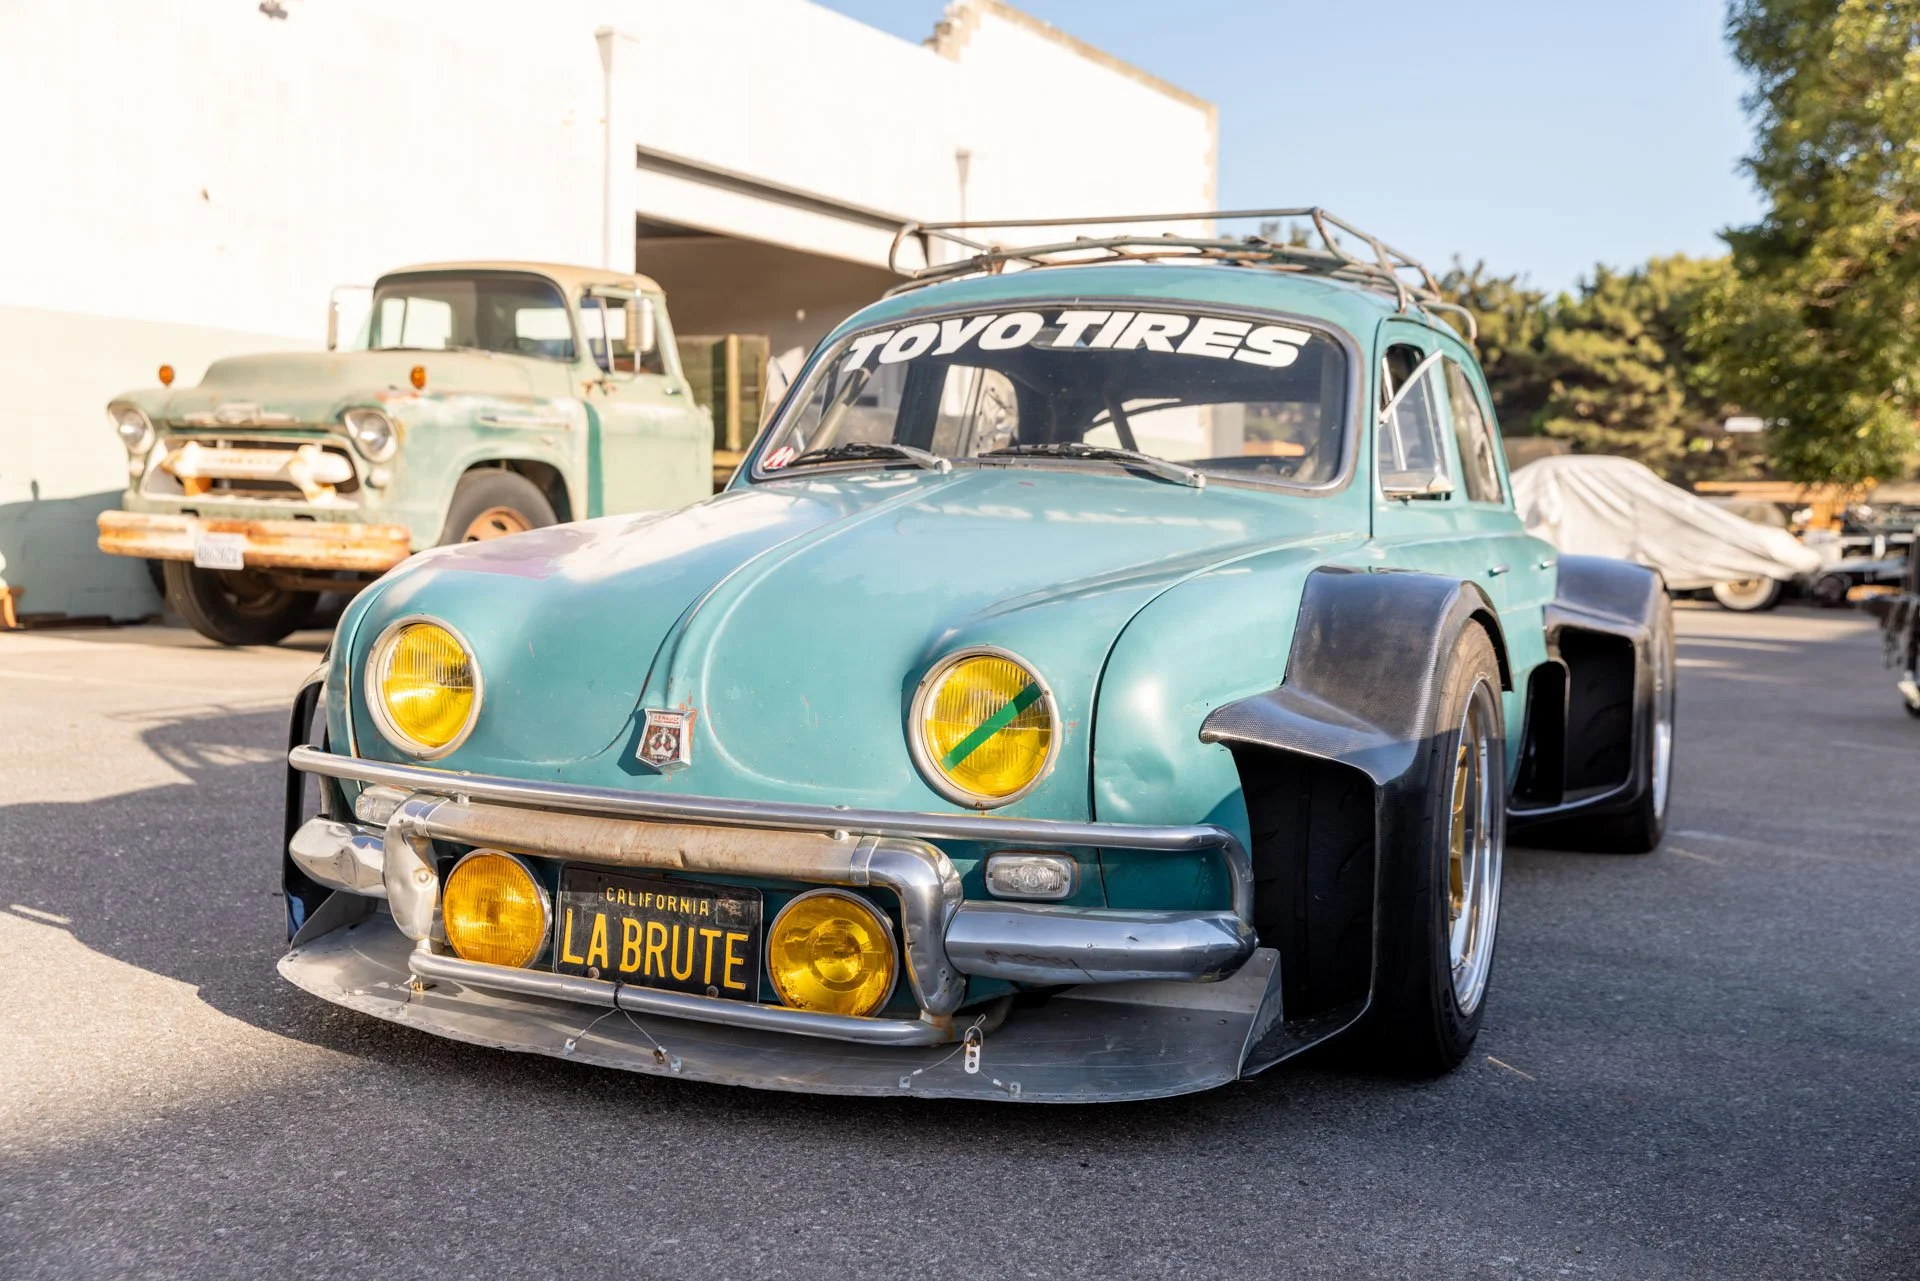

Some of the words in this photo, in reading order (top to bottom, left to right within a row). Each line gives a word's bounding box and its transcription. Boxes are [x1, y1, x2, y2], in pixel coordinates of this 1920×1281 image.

[843, 311, 1044, 373] TOYO
[1051, 310, 1312, 369] TIRES
[606, 887, 709, 916] CALIFORNIA
[561, 908, 609, 969] LA
[619, 917, 749, 990] BRUTE
